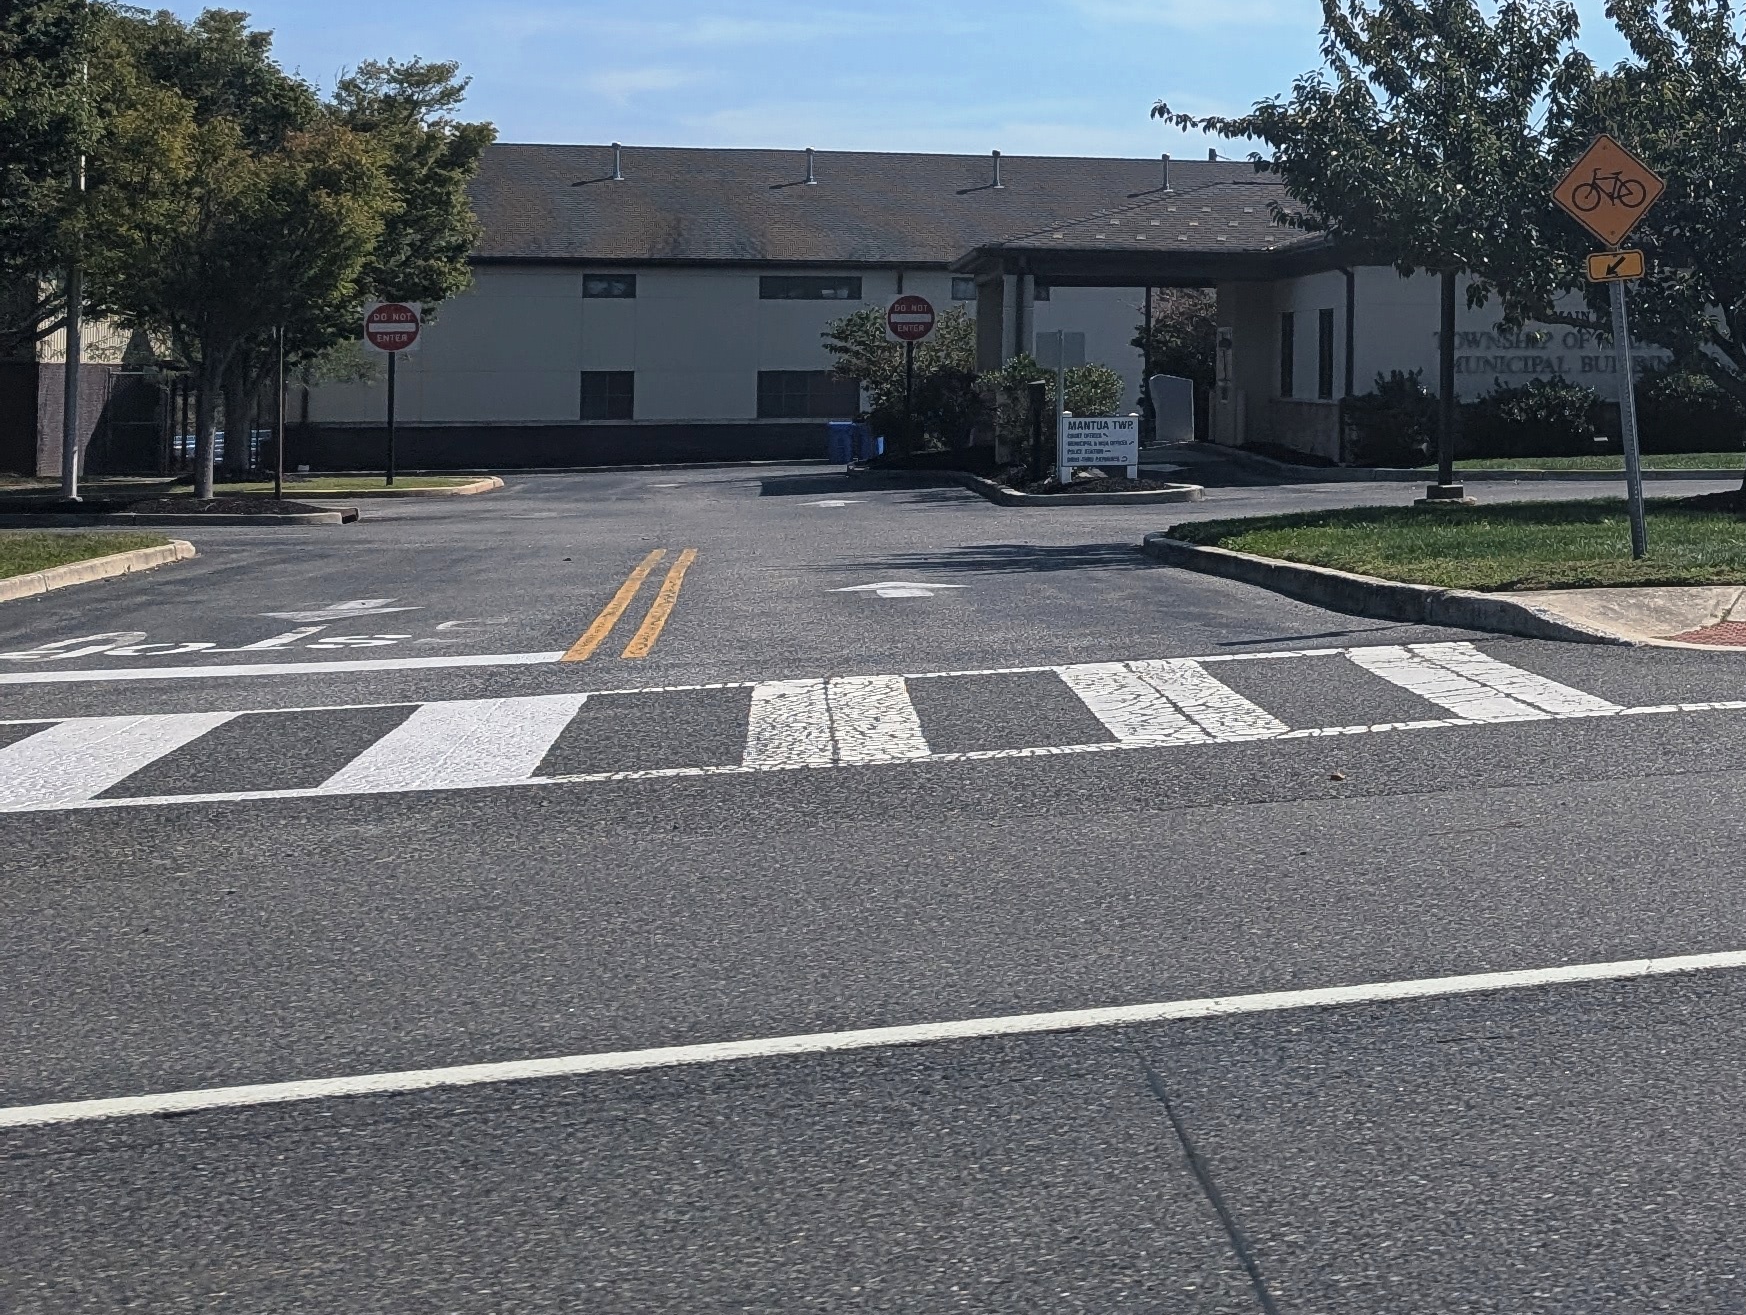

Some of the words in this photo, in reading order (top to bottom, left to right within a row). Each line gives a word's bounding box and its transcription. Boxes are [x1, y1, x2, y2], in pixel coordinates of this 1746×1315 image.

[392, 313, 412, 321] NOT
[377, 334, 408, 342] ENTER
[1068, 421, 1109, 430] MANTUA
[1112, 421, 1133, 429] TWP.
